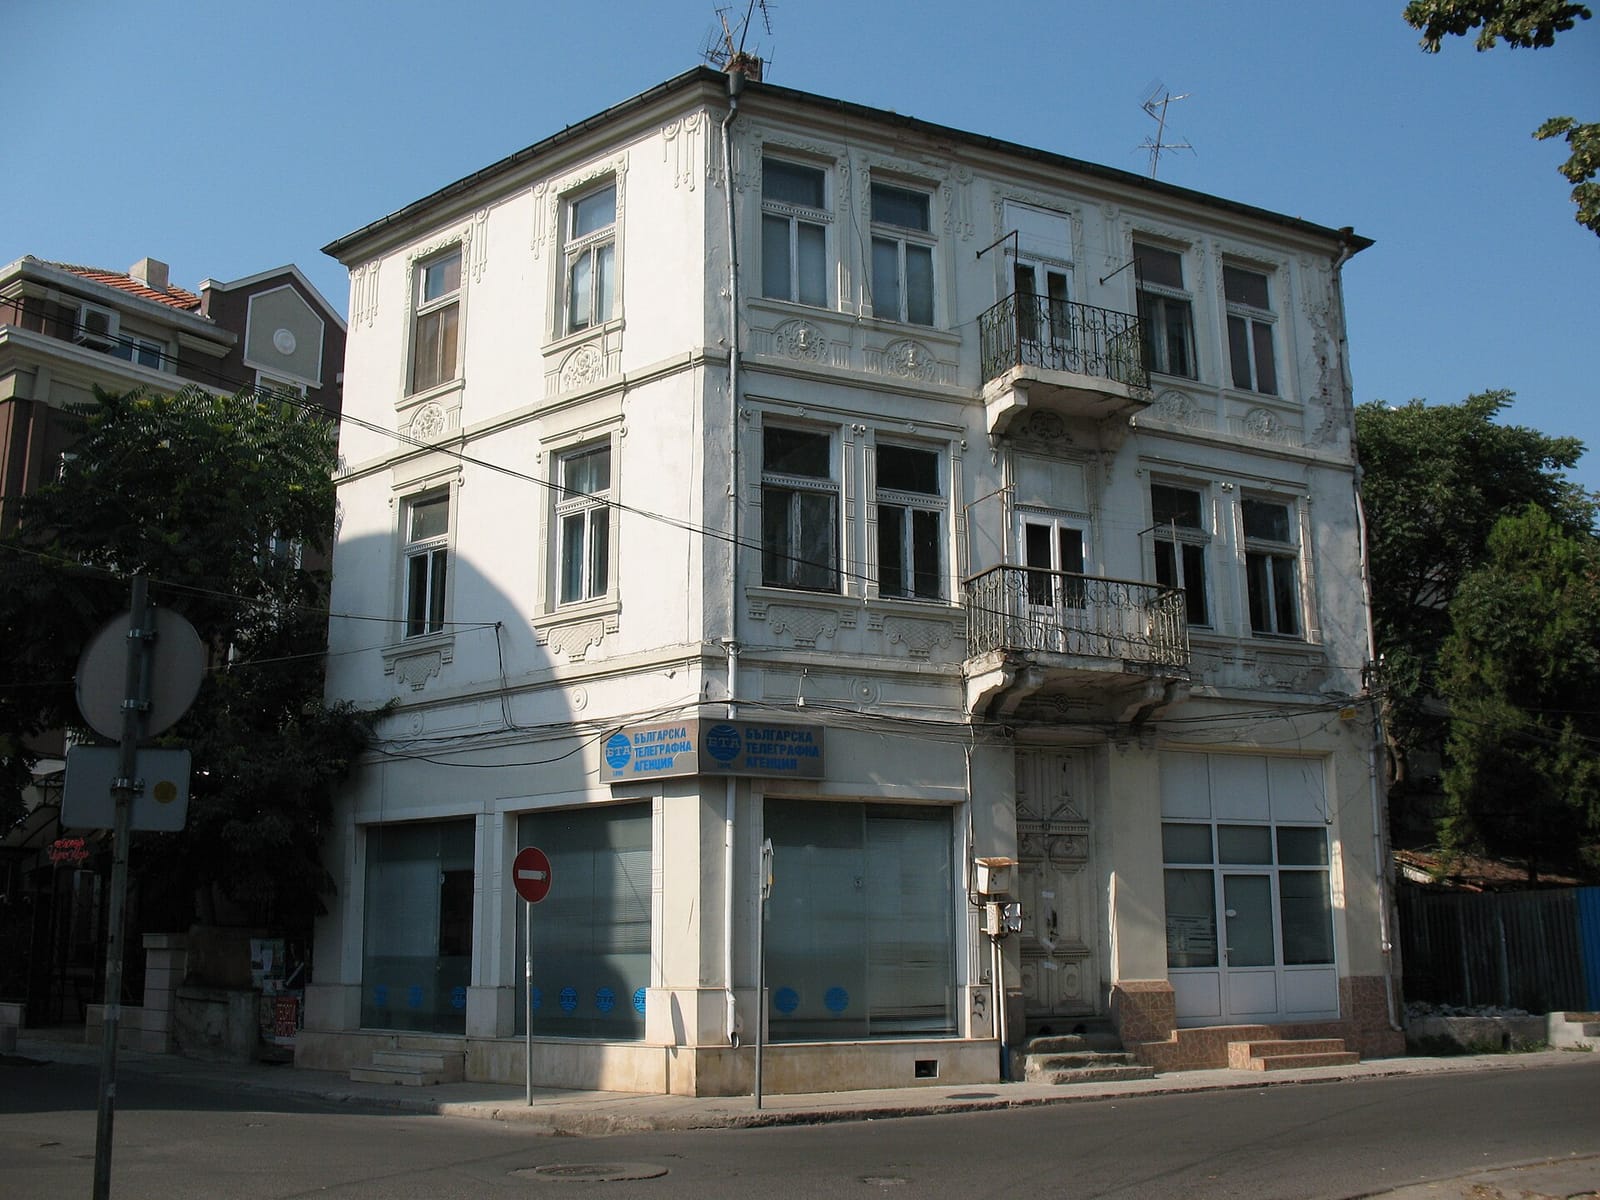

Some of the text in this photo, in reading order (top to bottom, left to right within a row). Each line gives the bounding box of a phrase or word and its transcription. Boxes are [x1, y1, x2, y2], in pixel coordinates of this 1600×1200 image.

[634, 727, 686, 744] БЪЛГАРСКА
[745, 727, 813, 742] БЪЛГАРСКА
[635, 740, 691, 758] ТЕЛЕГРАФНА
[746, 742, 819, 757] ТЕЛЕГРАФНА
[634, 757, 673, 772] АГЕНЦИЯ
[745, 756, 797, 769] АГЕНЦИЯ
